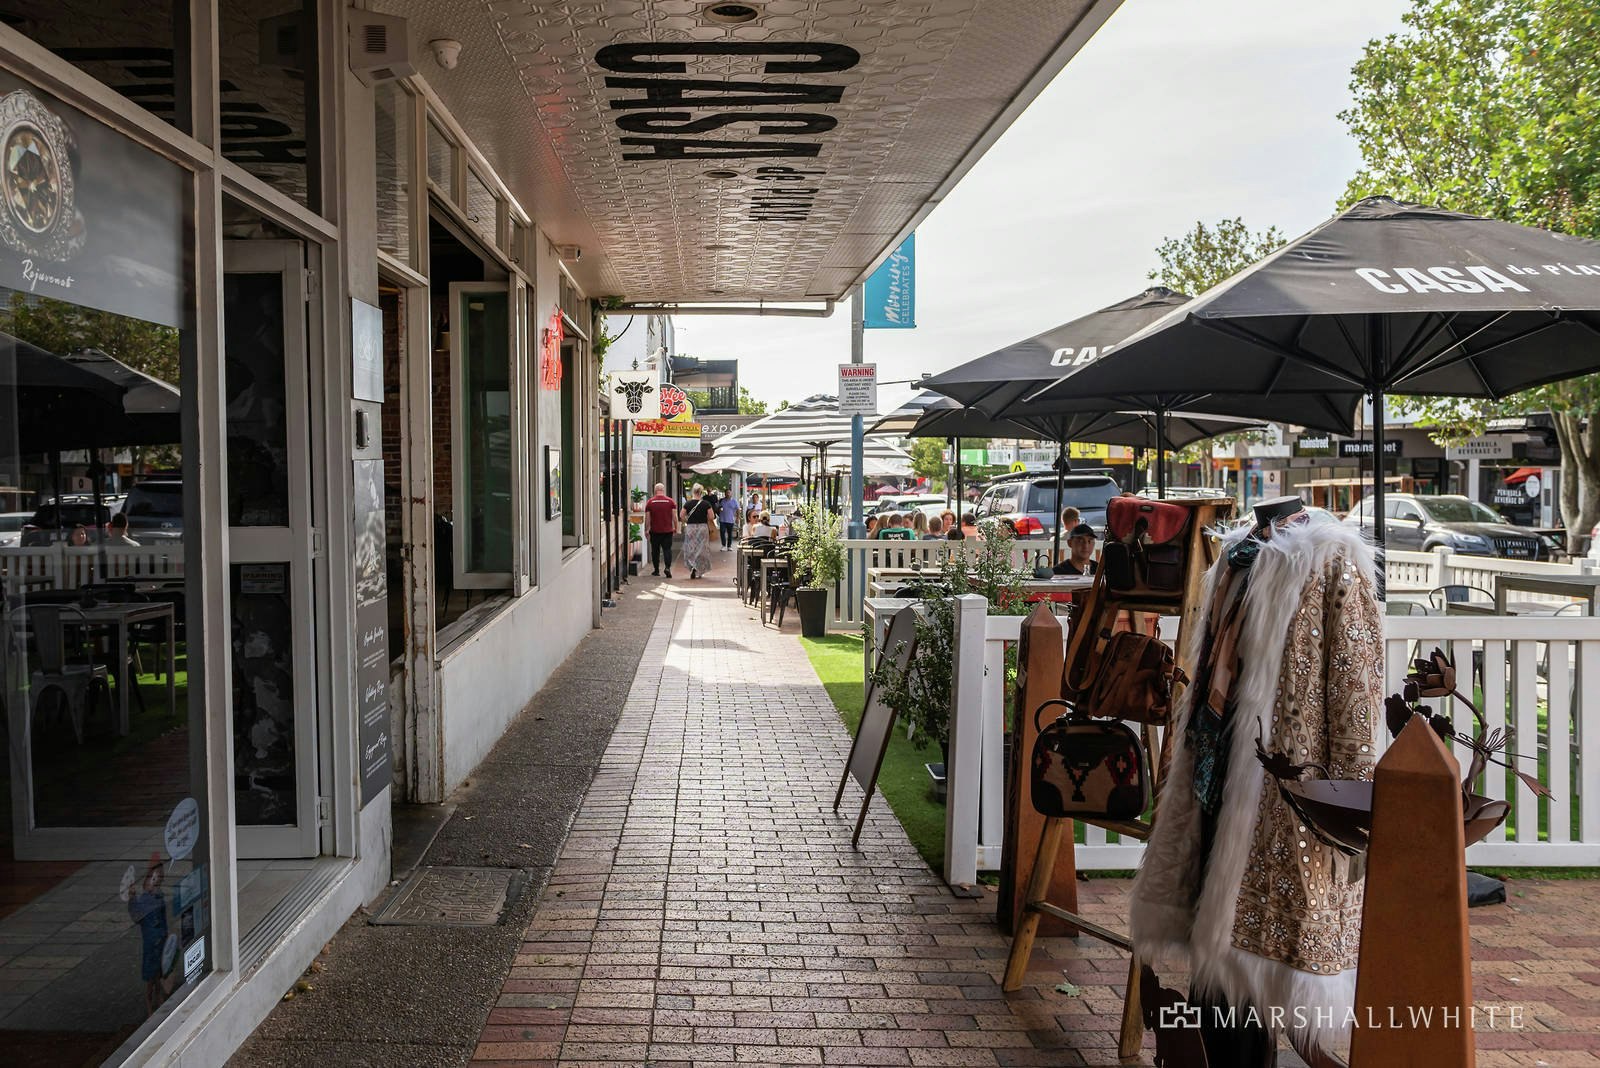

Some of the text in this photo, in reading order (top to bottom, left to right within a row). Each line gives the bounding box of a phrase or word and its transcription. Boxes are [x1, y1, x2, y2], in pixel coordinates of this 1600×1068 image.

[594, 41, 861, 161] CASA
[883, 246, 909, 324] Morning
[1355, 266, 1531, 294] CASA
[901, 265, 910, 324] CELEBRATES
[1050, 345, 1115, 366] CA
[841, 368, 874, 377] WARNING
[636, 439, 697, 450] BAKESHOP
